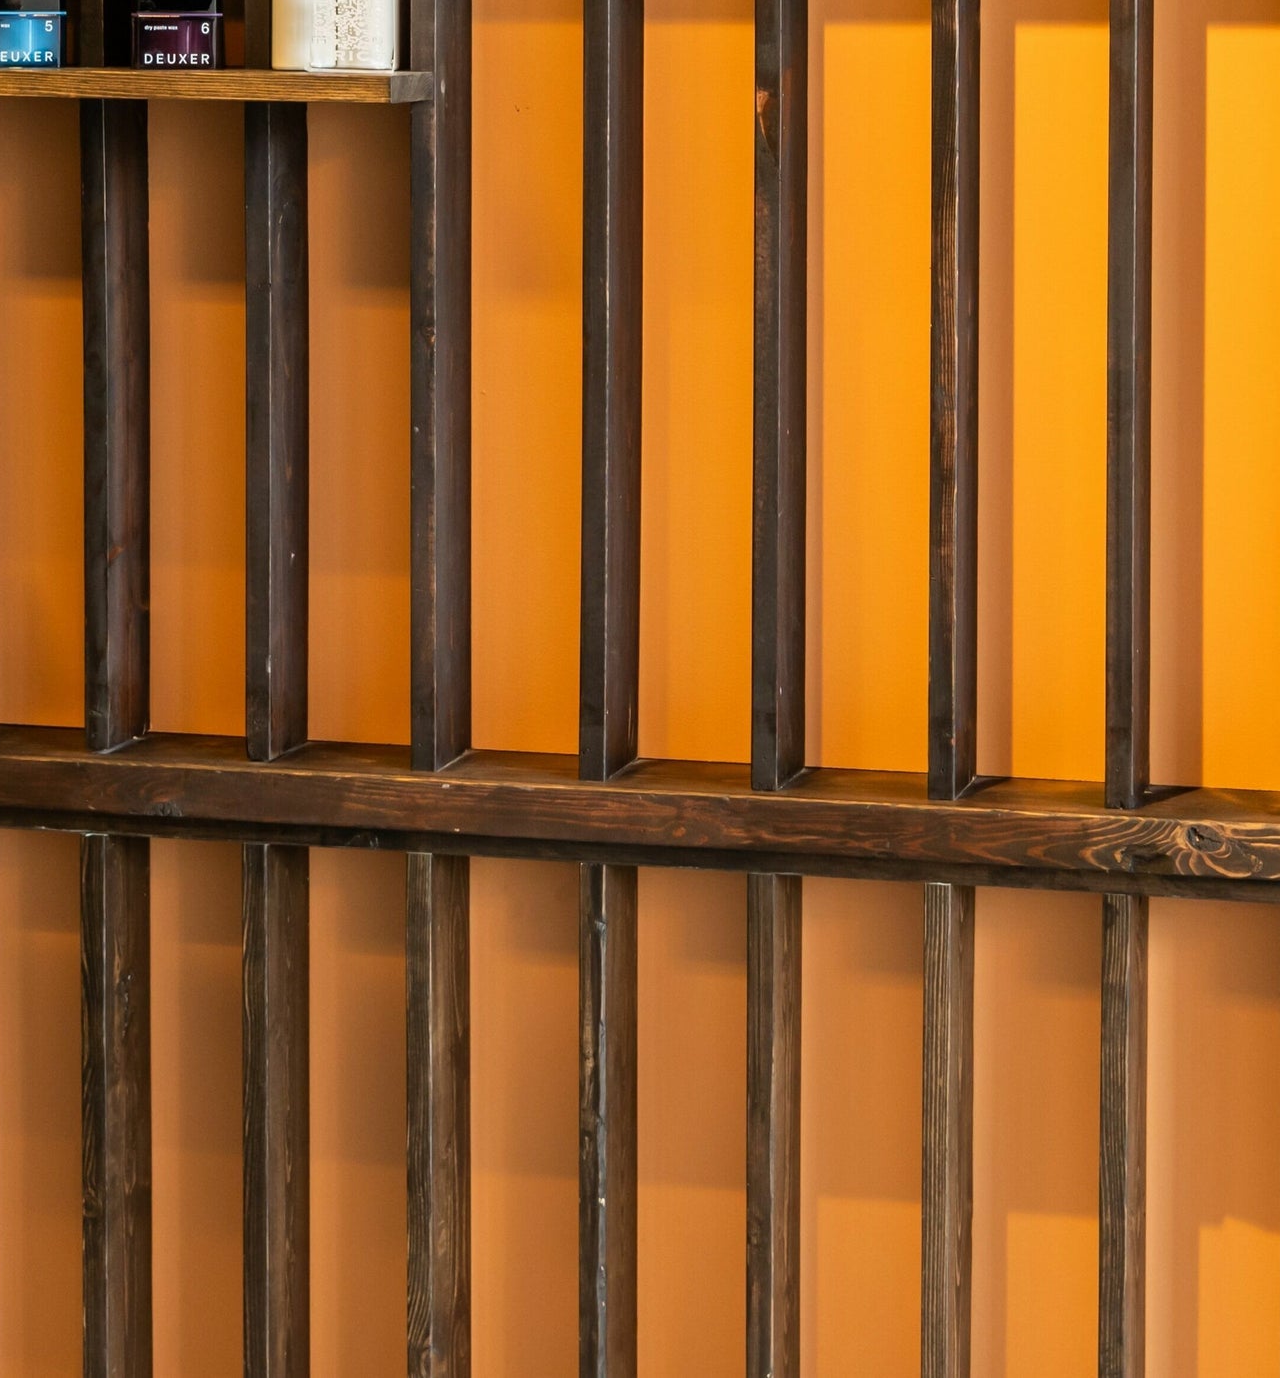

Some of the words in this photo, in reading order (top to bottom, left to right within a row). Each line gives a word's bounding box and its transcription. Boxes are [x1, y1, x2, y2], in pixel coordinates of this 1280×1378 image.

[45, 21, 53, 31] 5
[201, 23, 209, 34] 6
[144, 54, 209, 64] DEUXER
